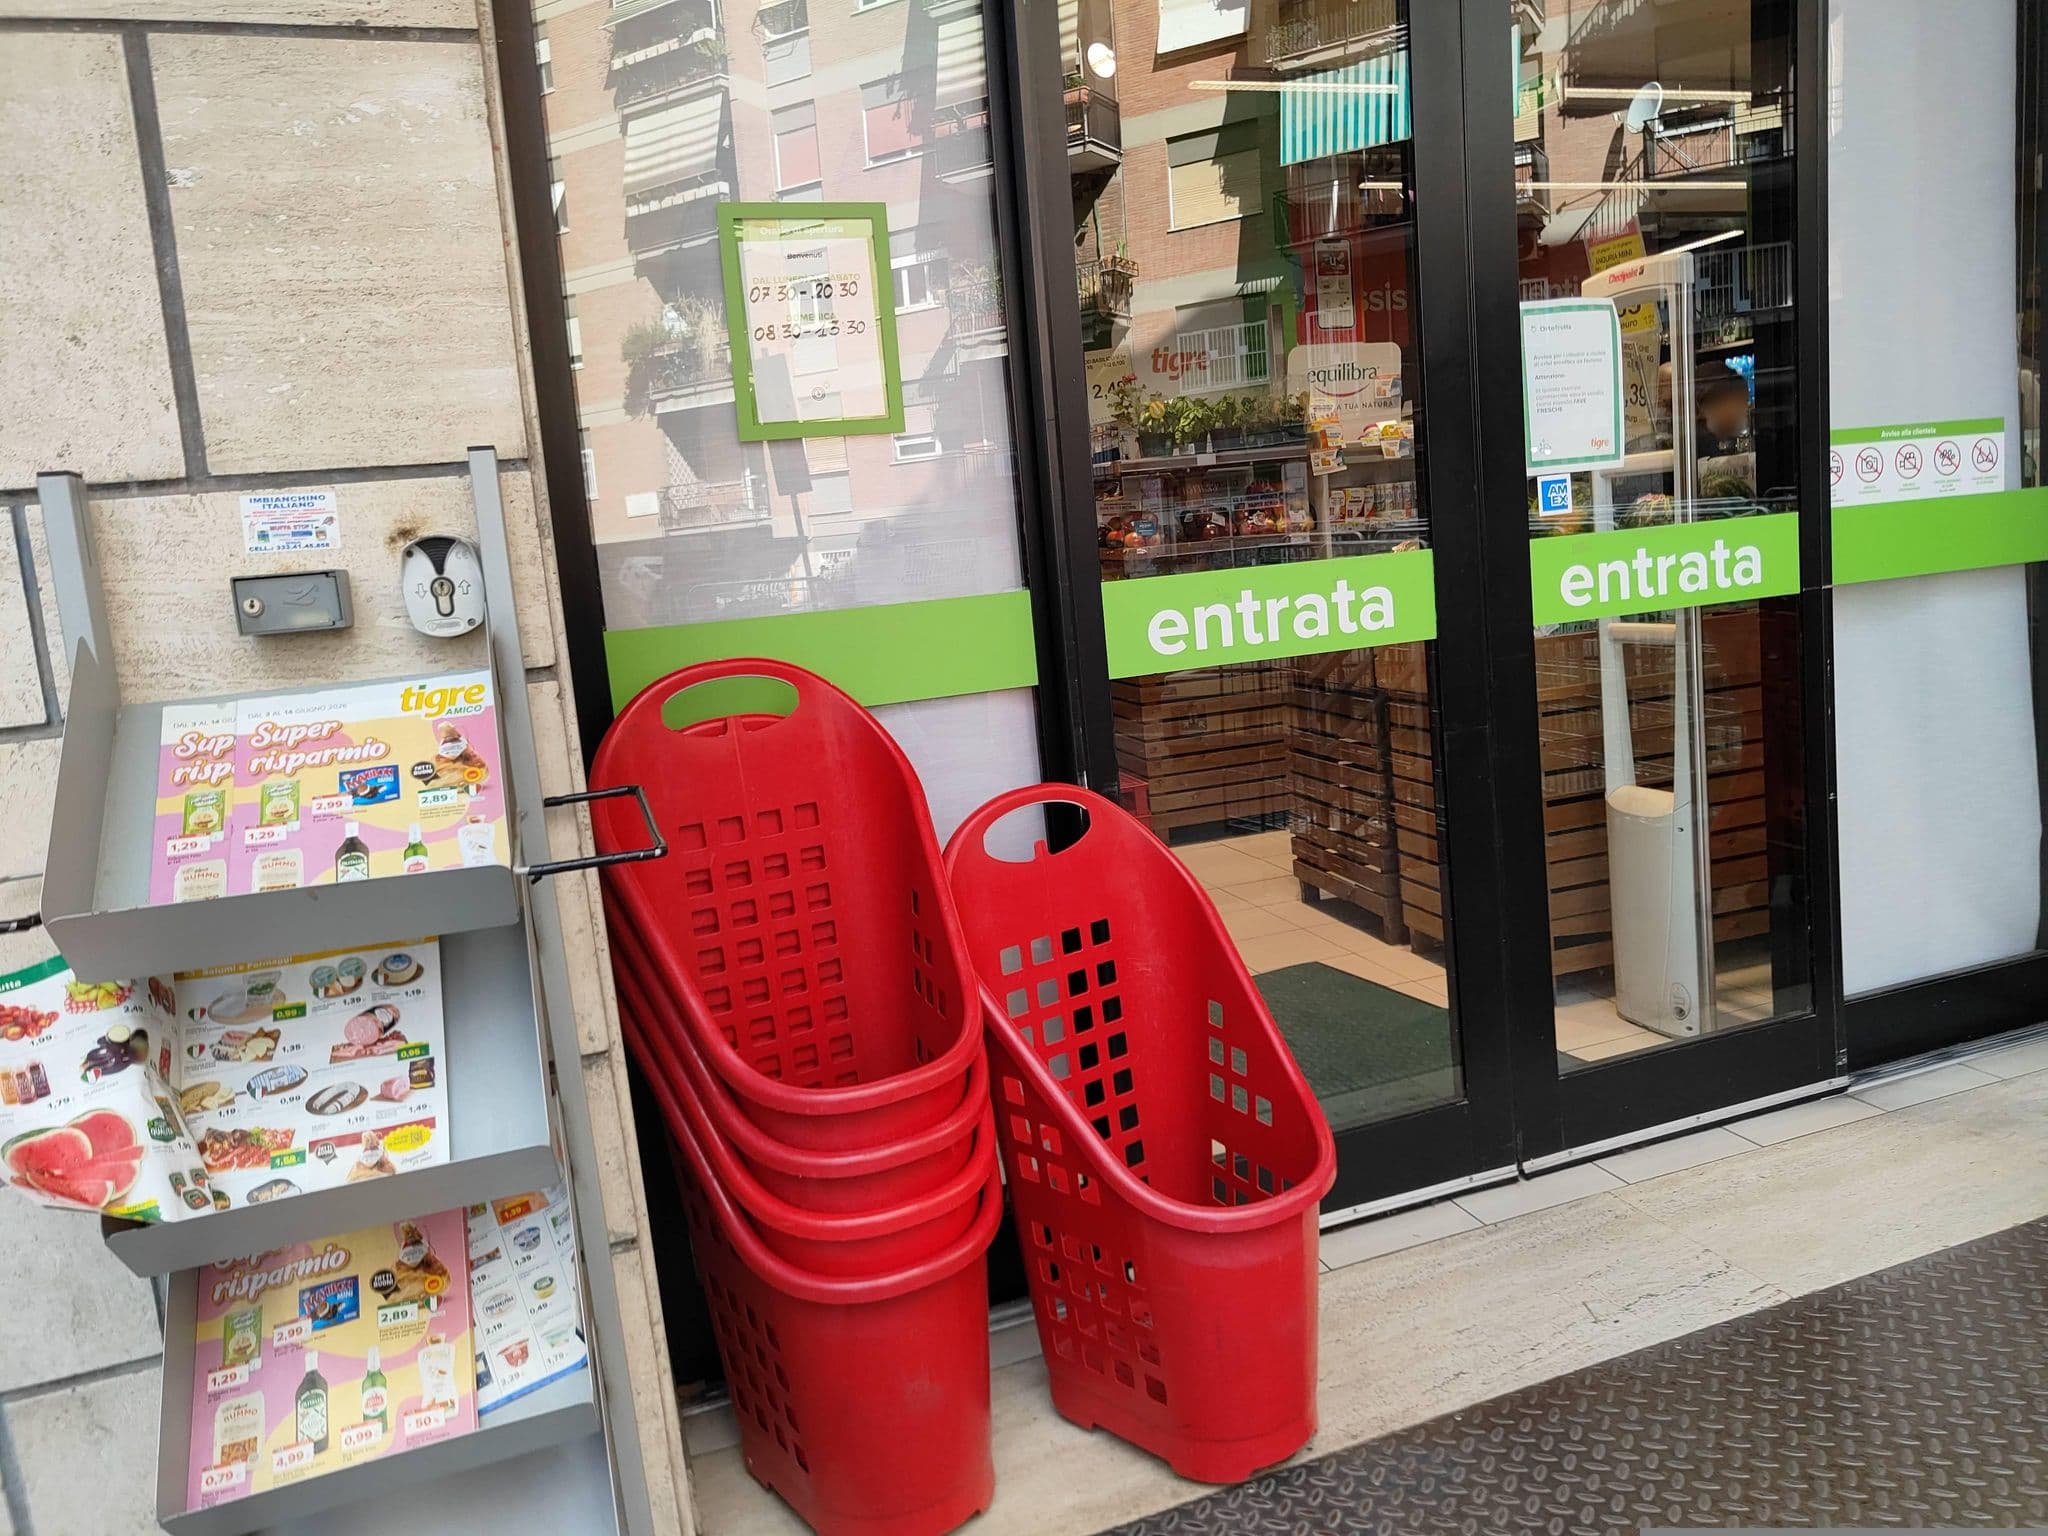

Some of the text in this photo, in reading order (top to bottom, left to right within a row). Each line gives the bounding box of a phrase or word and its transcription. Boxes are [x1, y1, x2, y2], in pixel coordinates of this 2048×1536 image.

[1151, 346, 1208, 381] tigre
[1307, 363, 1377, 387] equilibra
[1361, 400, 1393, 409] NATURA
[1881, 427, 1937, 439] Avviso alla clientela
[1549, 485, 1567, 496] AM
[249, 495, 326, 504] IMBIANCHINO
[1552, 495, 1567, 505] EX
[1560, 539, 1762, 606] entrata
[1148, 580, 1395, 655] entrata
[400, 683, 486, 718] tigre
[295, 704, 326, 714] GIUGNO
[445, 705, 483, 716] AMICO
[250, 721, 341, 748] Super
[175, 732, 236, 758] Sup
[250, 738, 387, 774] risparmio
[173, 761, 236, 785] risp
[315, 800, 343, 811] 2,99
[421, 794, 448, 804] 2,89
[249, 831, 275, 841] 1,29
[170, 842, 198, 852] 1,29
[214, 1246, 347, 1301] risparmio
[381, 1310, 408, 1323] 2,89
[277, 1327, 303, 1342] 2,99
[211, 1373, 237, 1387] 1,29
[223, 1407, 258, 1423] RUMMO
[344, 1430, 373, 1446] 0,99
[276, 1451, 304, 1467] 4,99
[204, 1471, 234, 1486] 0,79
